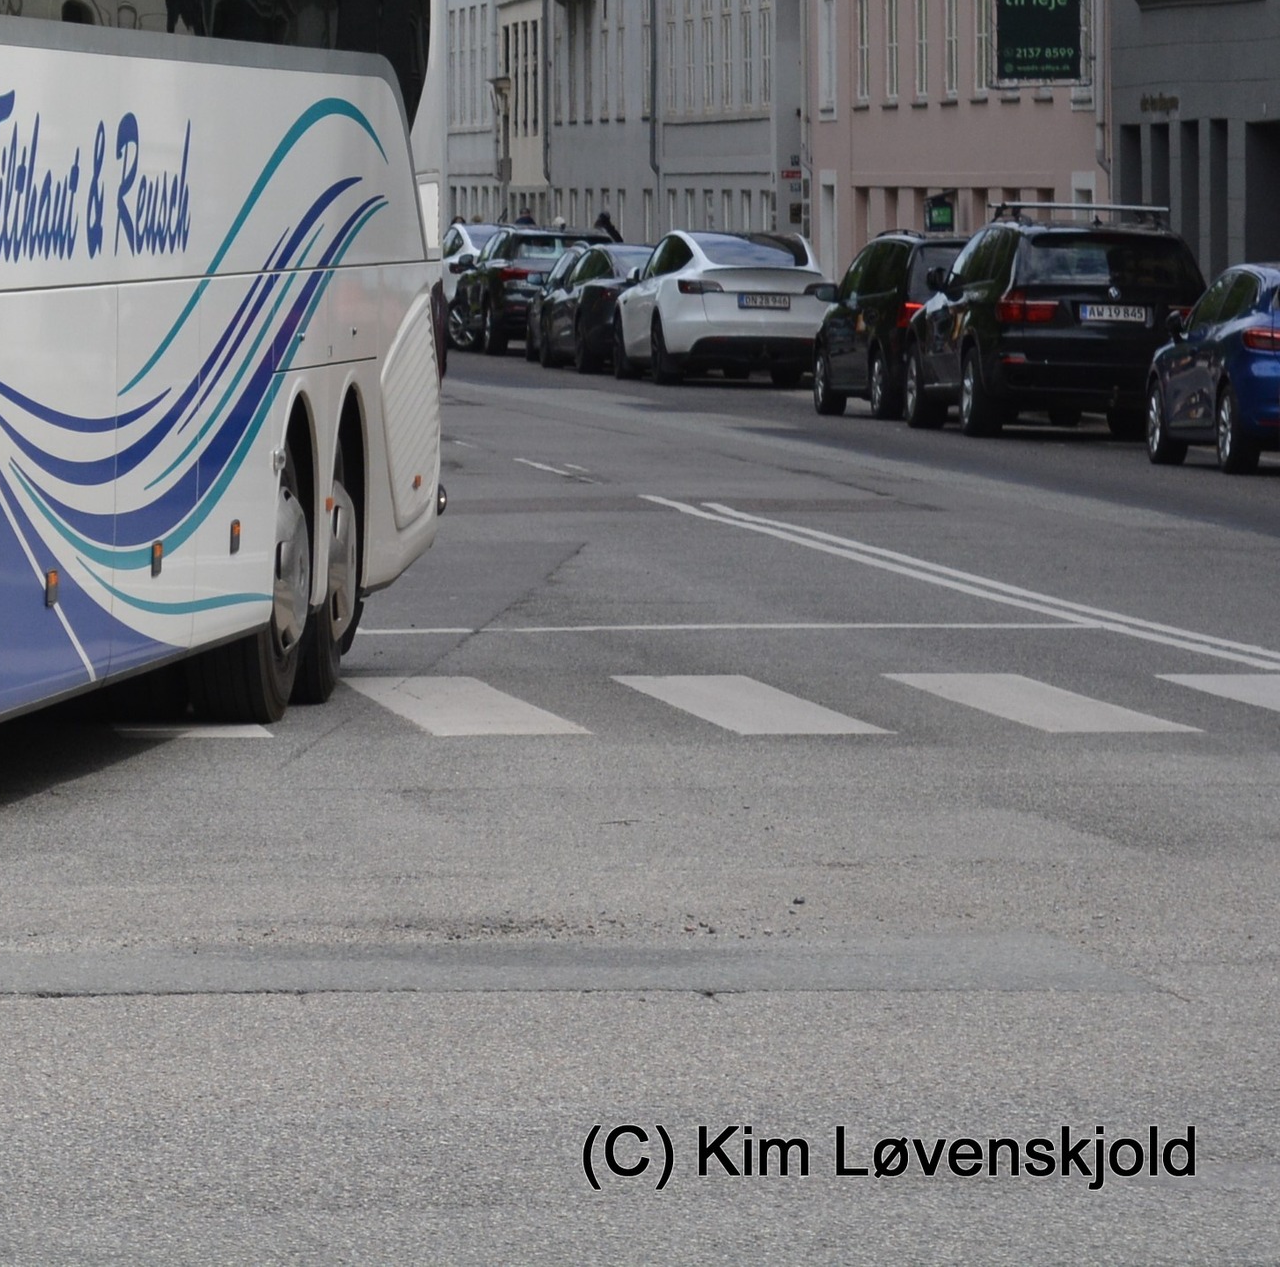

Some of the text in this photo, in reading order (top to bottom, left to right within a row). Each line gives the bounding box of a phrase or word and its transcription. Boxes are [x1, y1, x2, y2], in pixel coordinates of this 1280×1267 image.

[1016, 47, 1074, 59] 2137 8599
[86, 119, 105, 260] &
[114, 111, 191, 258] Reusch
[1089, 306, 1104, 318] AW
